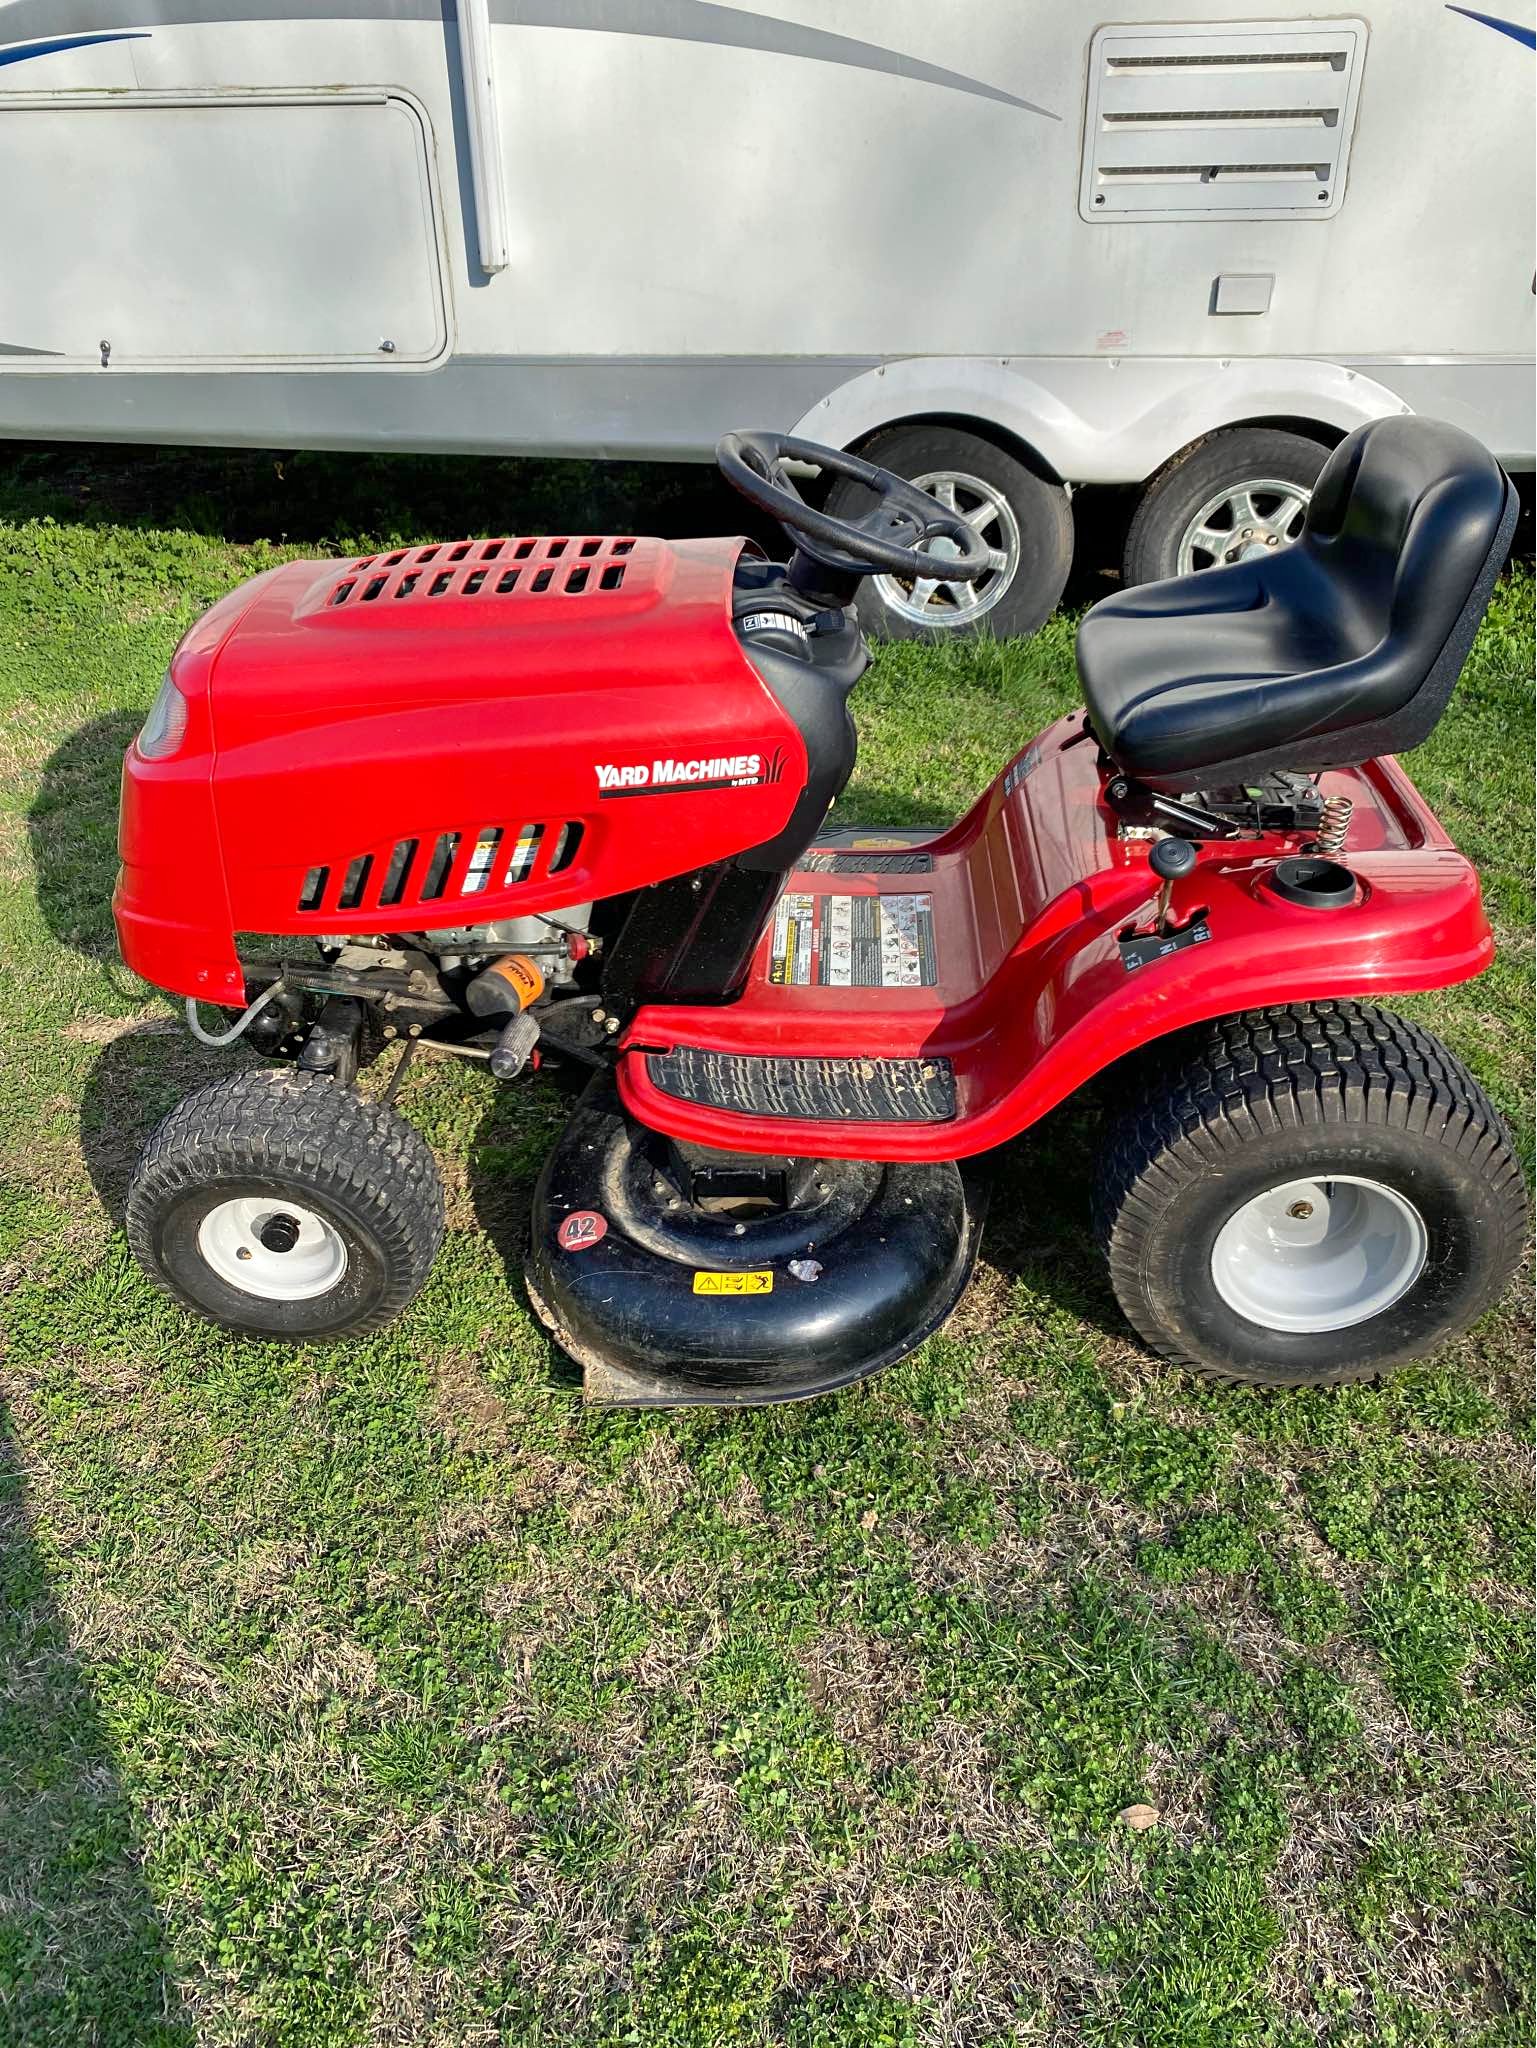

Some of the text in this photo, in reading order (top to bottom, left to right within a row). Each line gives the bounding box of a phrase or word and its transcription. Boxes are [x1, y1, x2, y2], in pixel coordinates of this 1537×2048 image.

[594, 754, 761, 788] YARD MACHINES
[731, 777, 759, 787] by MTD
[565, 1216, 597, 1239] 42
